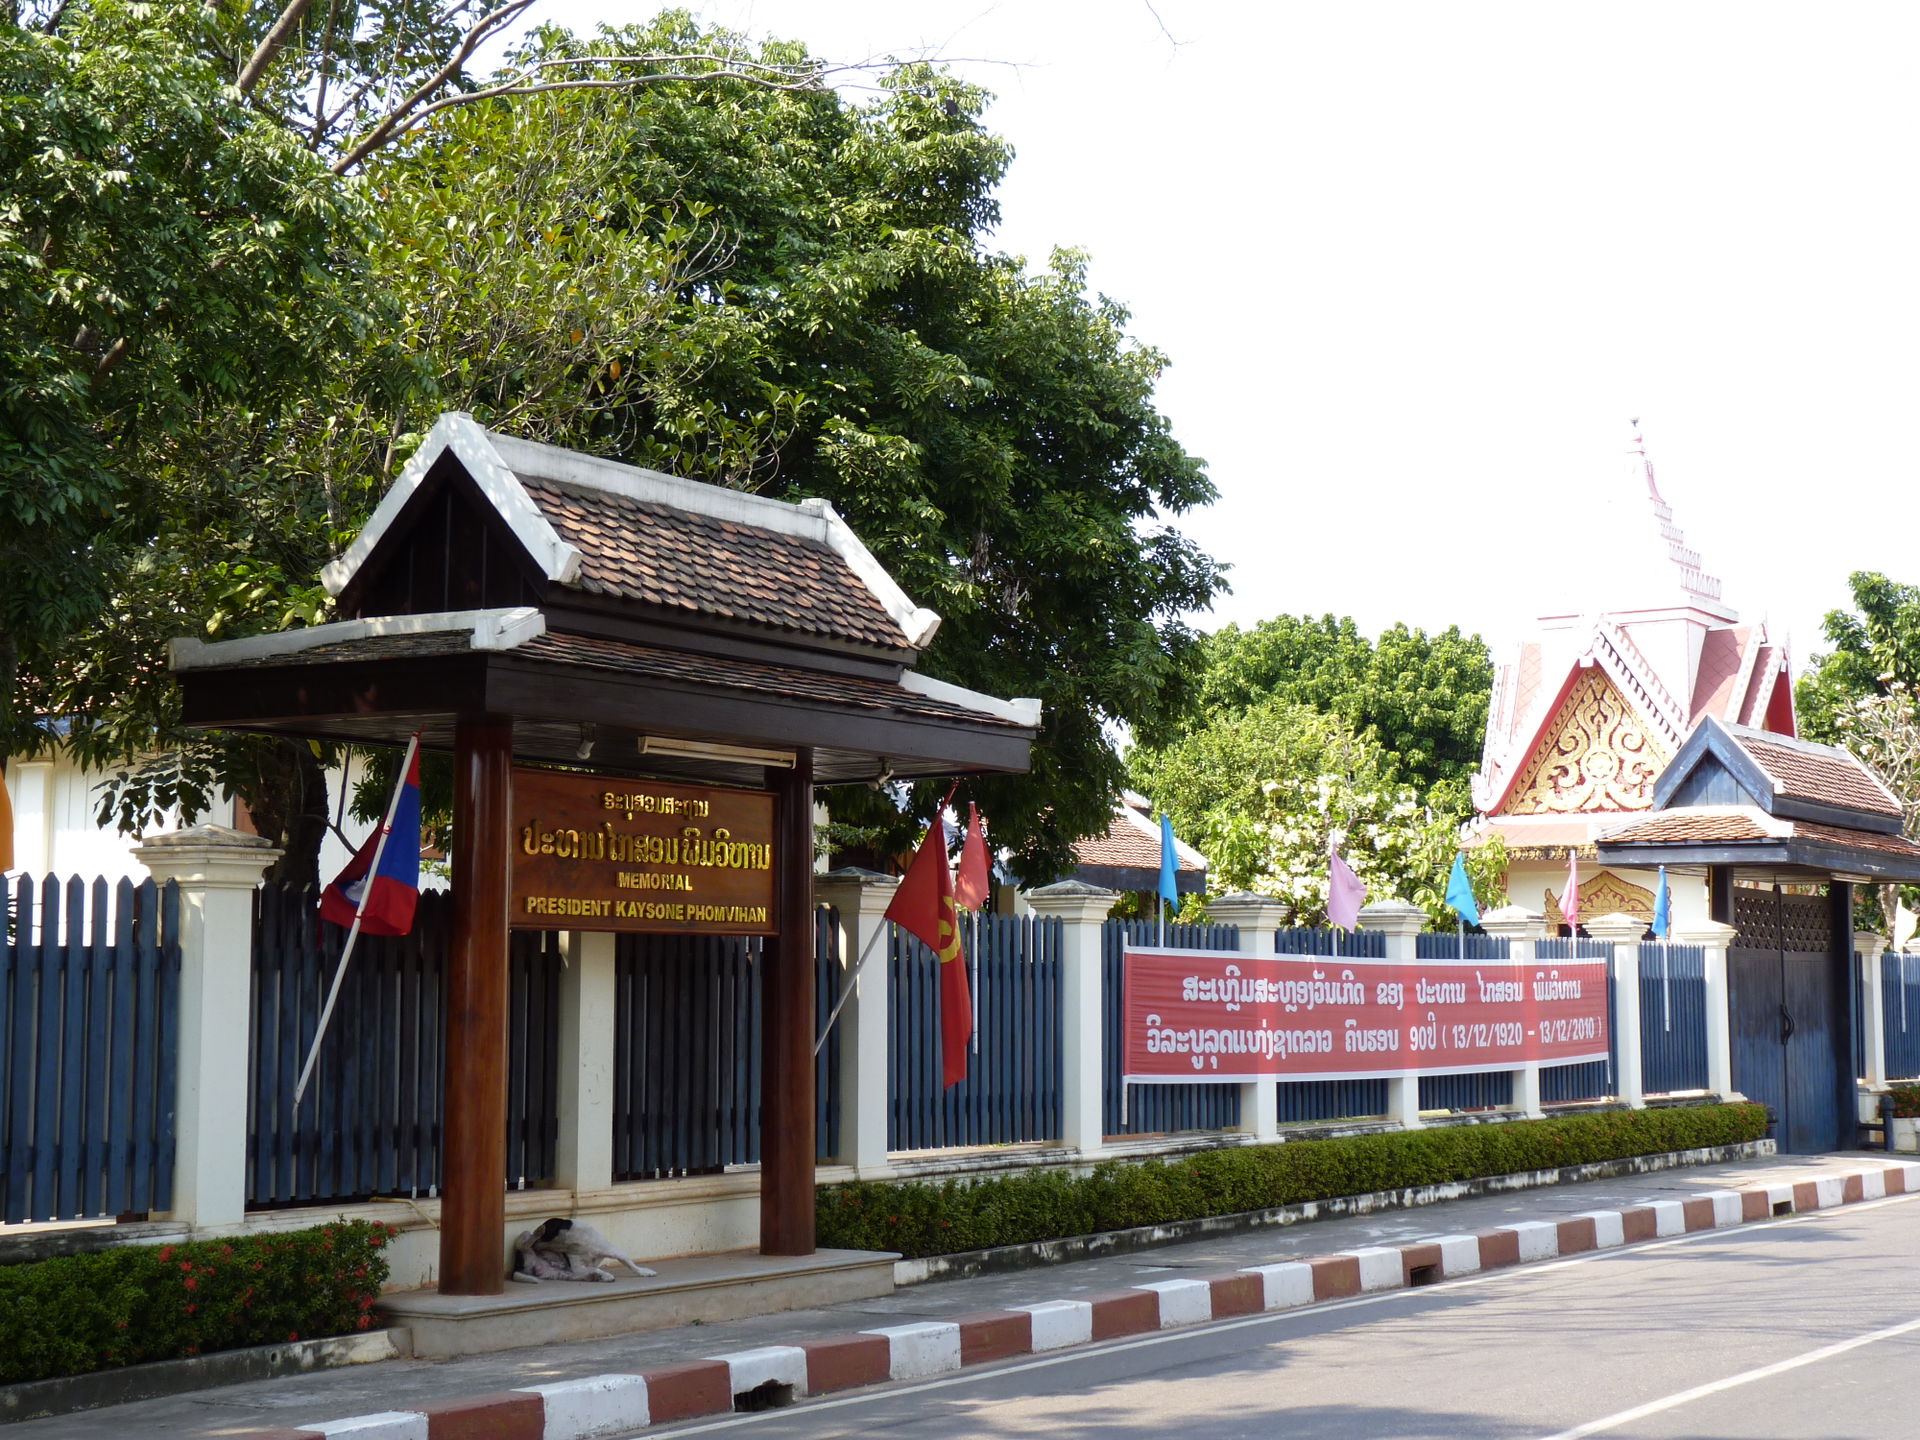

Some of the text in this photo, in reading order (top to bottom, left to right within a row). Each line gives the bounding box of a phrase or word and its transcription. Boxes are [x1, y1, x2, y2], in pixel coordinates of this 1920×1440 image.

[618, 871, 693, 891] MEMORIAL
[527, 896, 766, 923] PRESIDENT KAYSONE PHOMVIHAN
[1376, 982, 1404, 1011] ຂອງ
[1415, 977, 1466, 1004] ປະທານ
[1475, 970, 1523, 1003] ໄກສອນ
